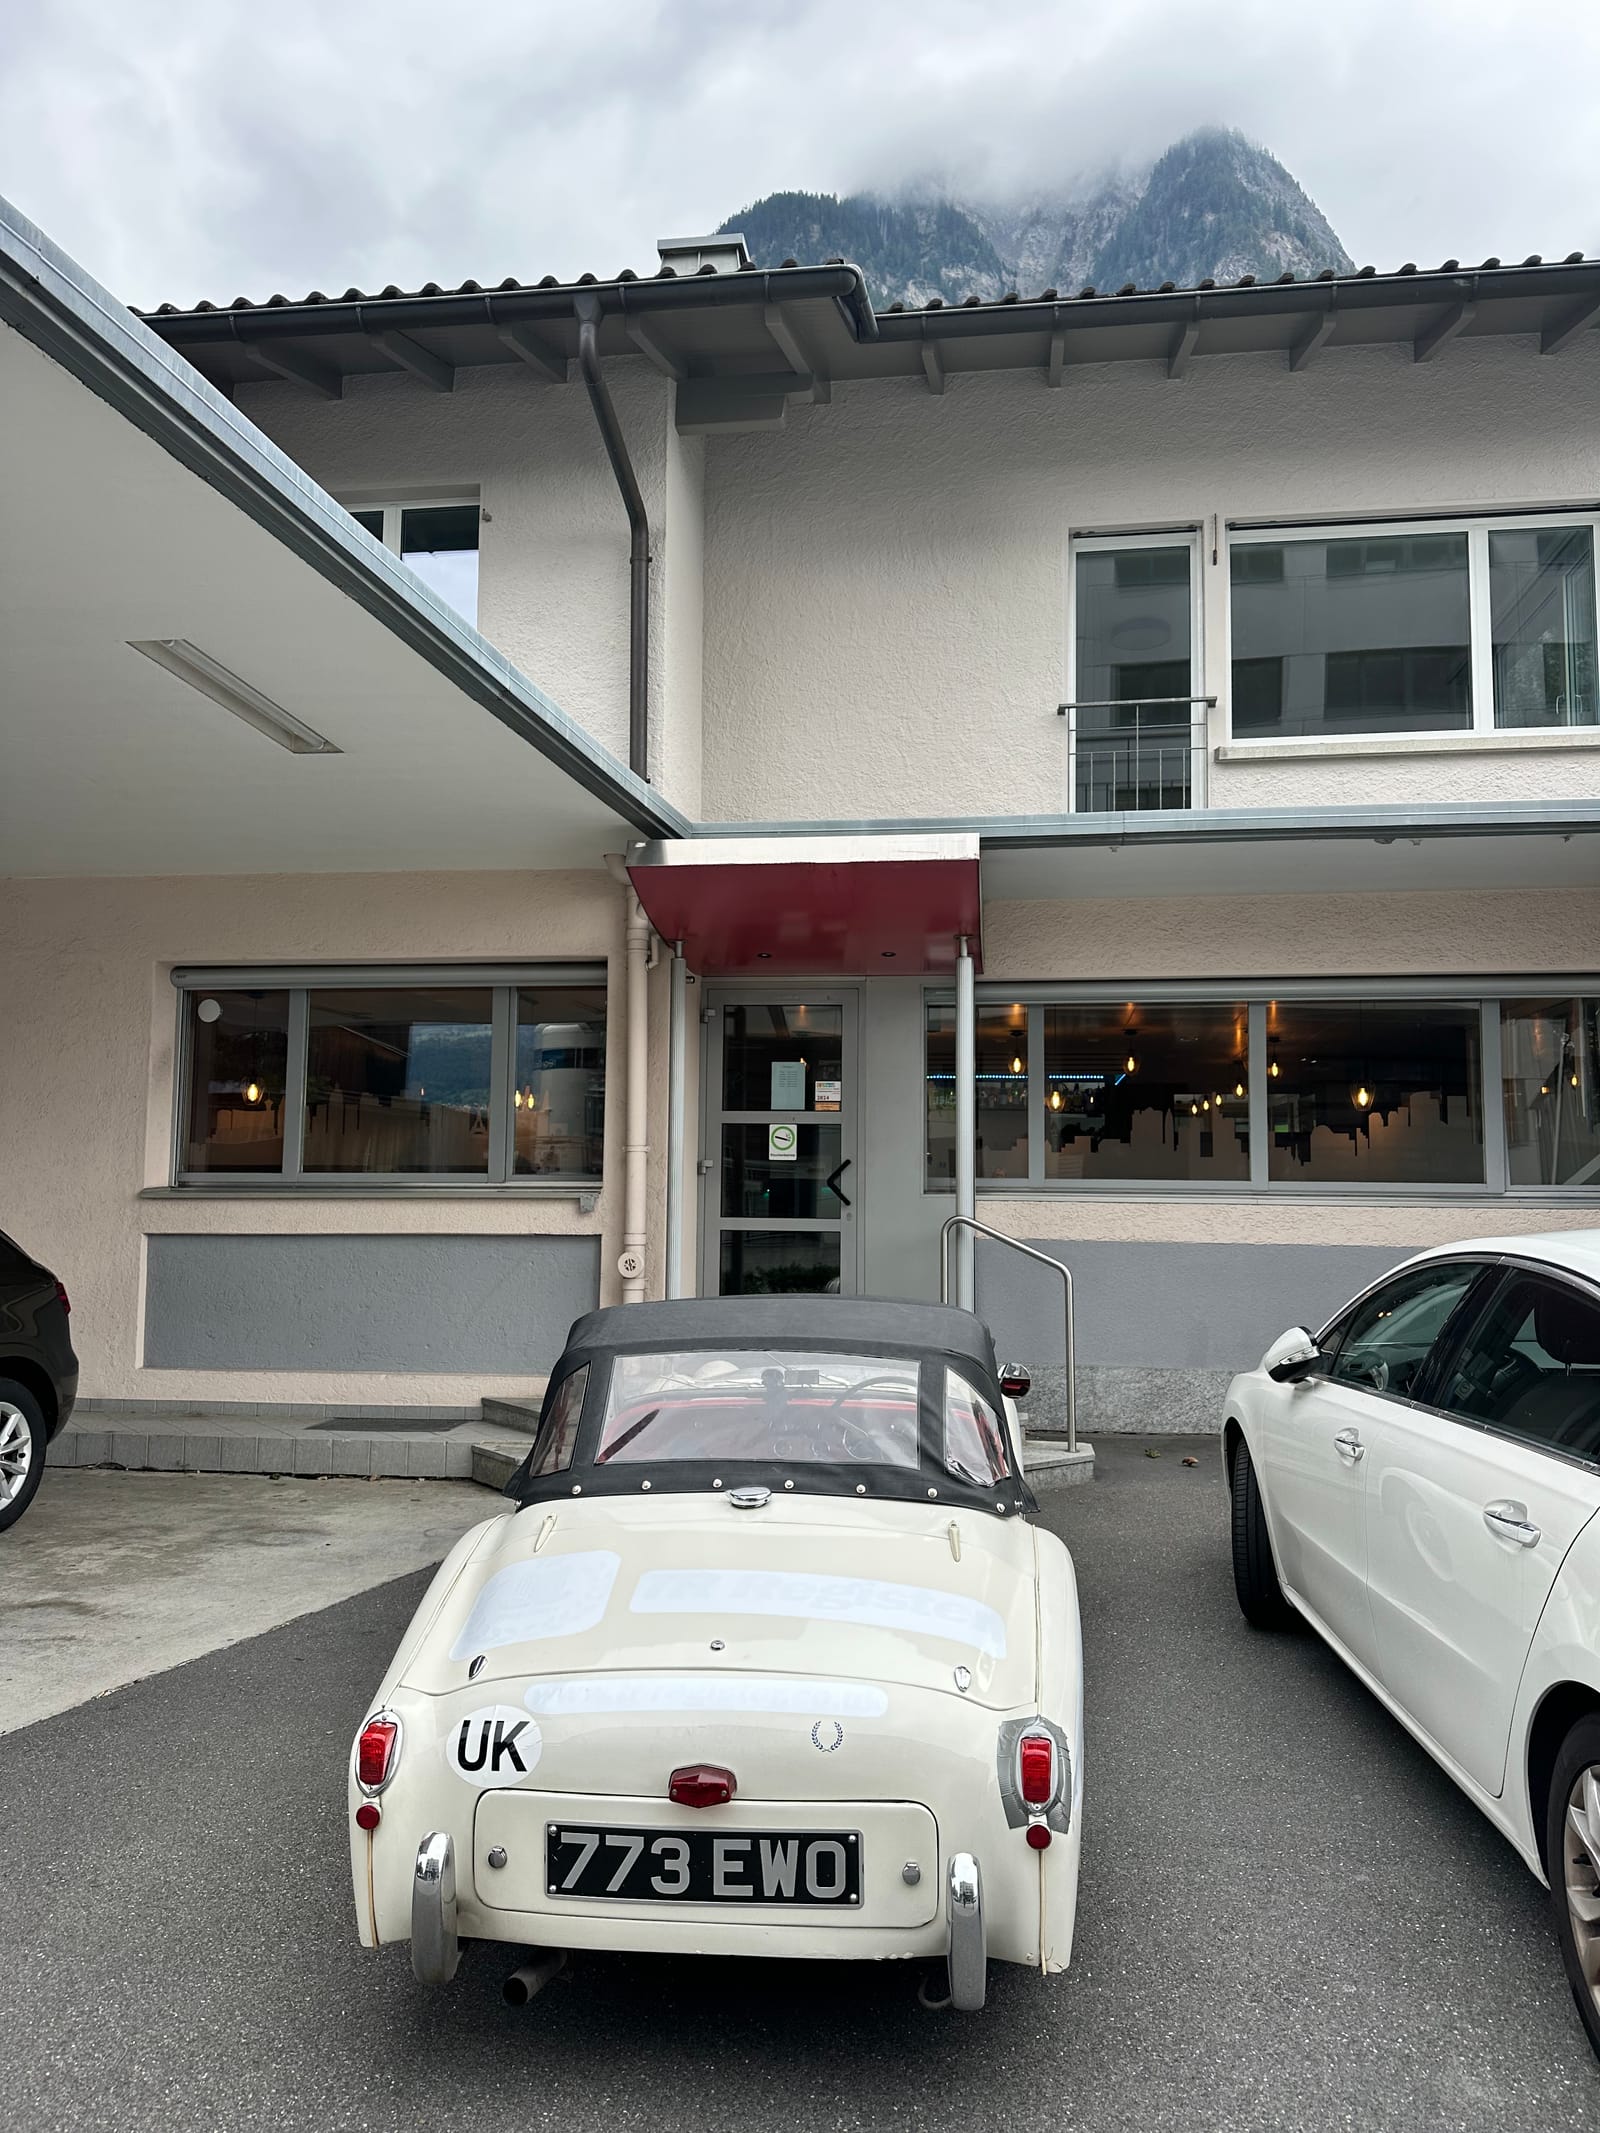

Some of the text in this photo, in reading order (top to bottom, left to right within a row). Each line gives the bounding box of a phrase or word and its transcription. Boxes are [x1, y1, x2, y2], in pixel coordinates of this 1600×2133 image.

[458, 1720, 530, 1772] UK
[560, 1832, 846, 1898] 773 EWO
